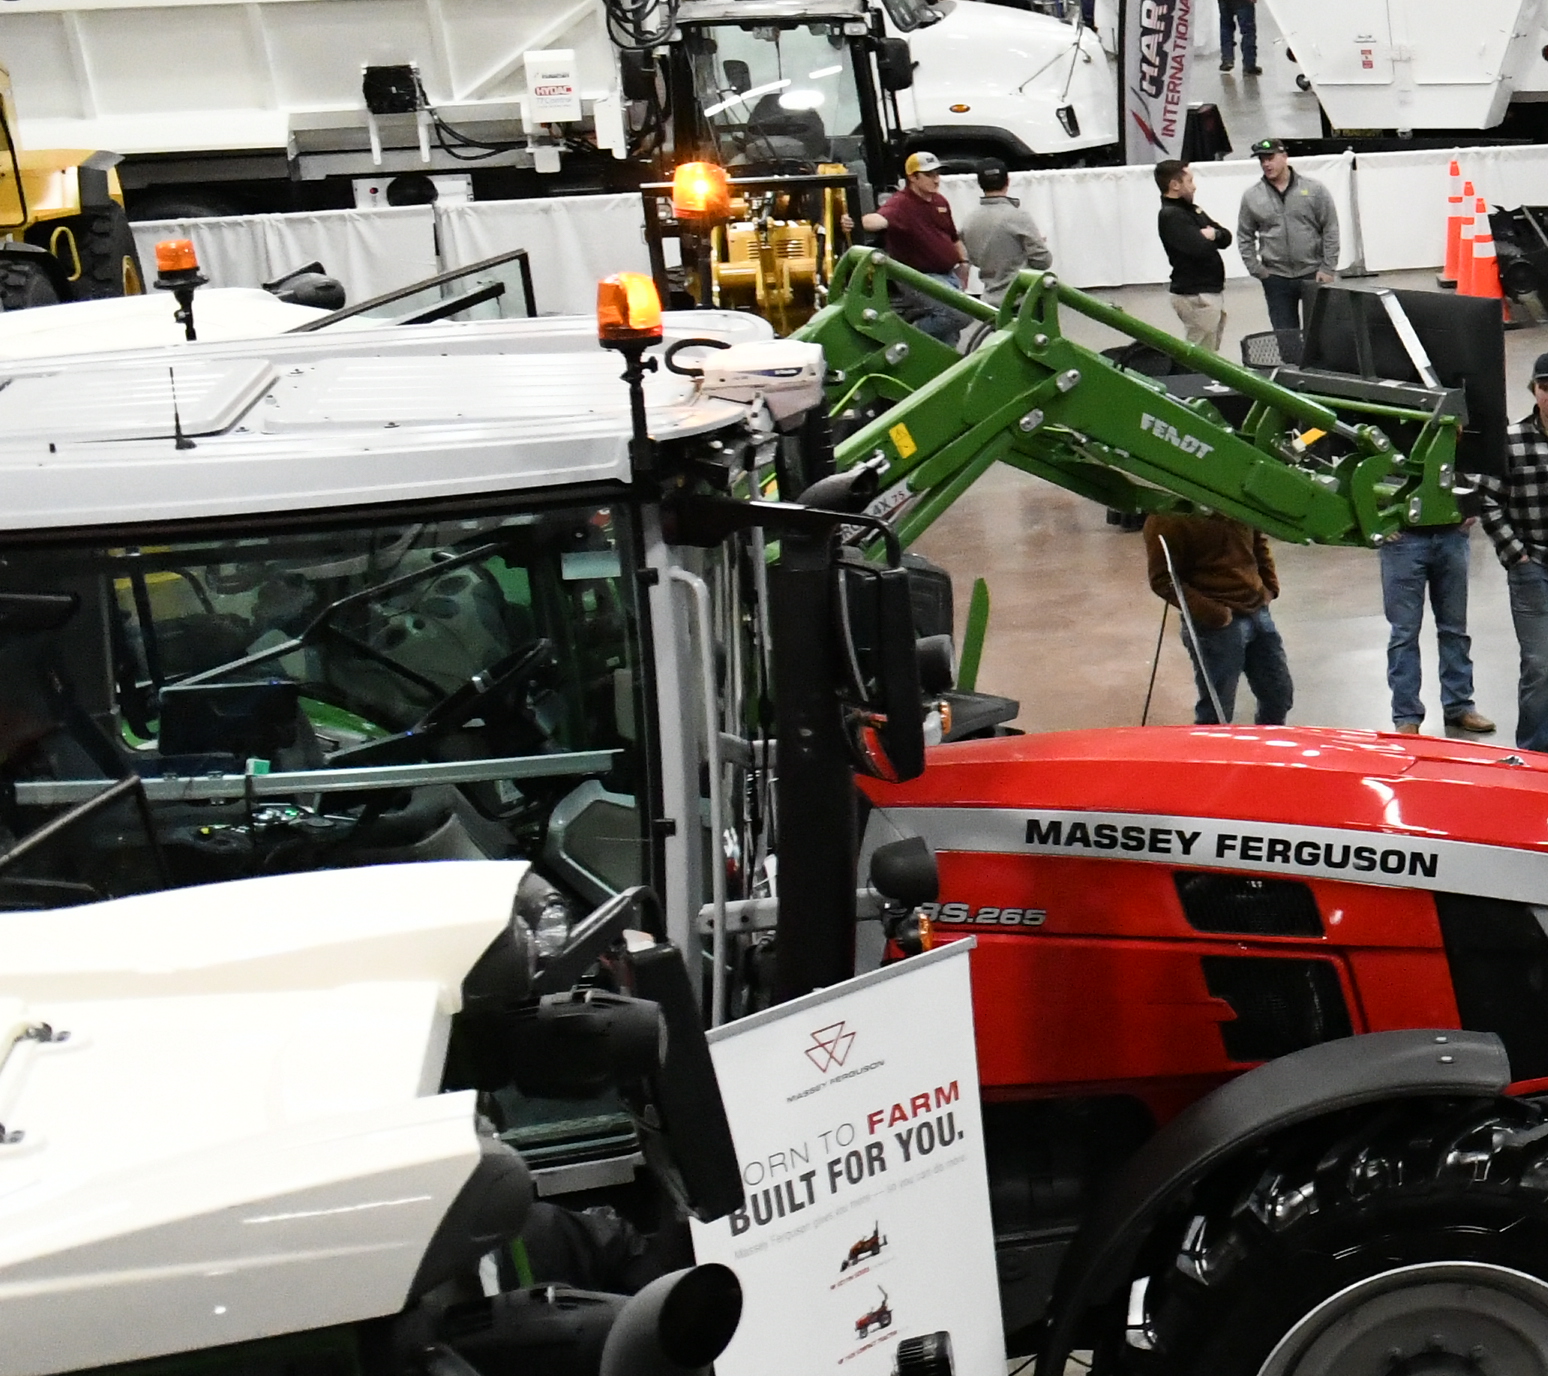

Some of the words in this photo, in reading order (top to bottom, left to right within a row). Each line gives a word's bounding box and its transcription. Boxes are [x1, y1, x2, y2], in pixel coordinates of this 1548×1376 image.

[1139, 412, 1215, 459] FENDT
[873, 497, 891, 516] 4X
[1023, 819, 1202, 855] MASSEY
[1215, 833, 1439, 879] FERGUSON
[786, 1083, 827, 1103] MASSEY
[830, 1060, 885, 1086] FERGUSON
[742, 1143, 810, 1187] ORN
[817, 1122, 856, 1156] TO
[866, 1080, 960, 1135] FARM
[728, 1170, 816, 1238] BUILT
[827, 1140, 887, 1195] FOR
[894, 1112, 965, 1165] YOU.
